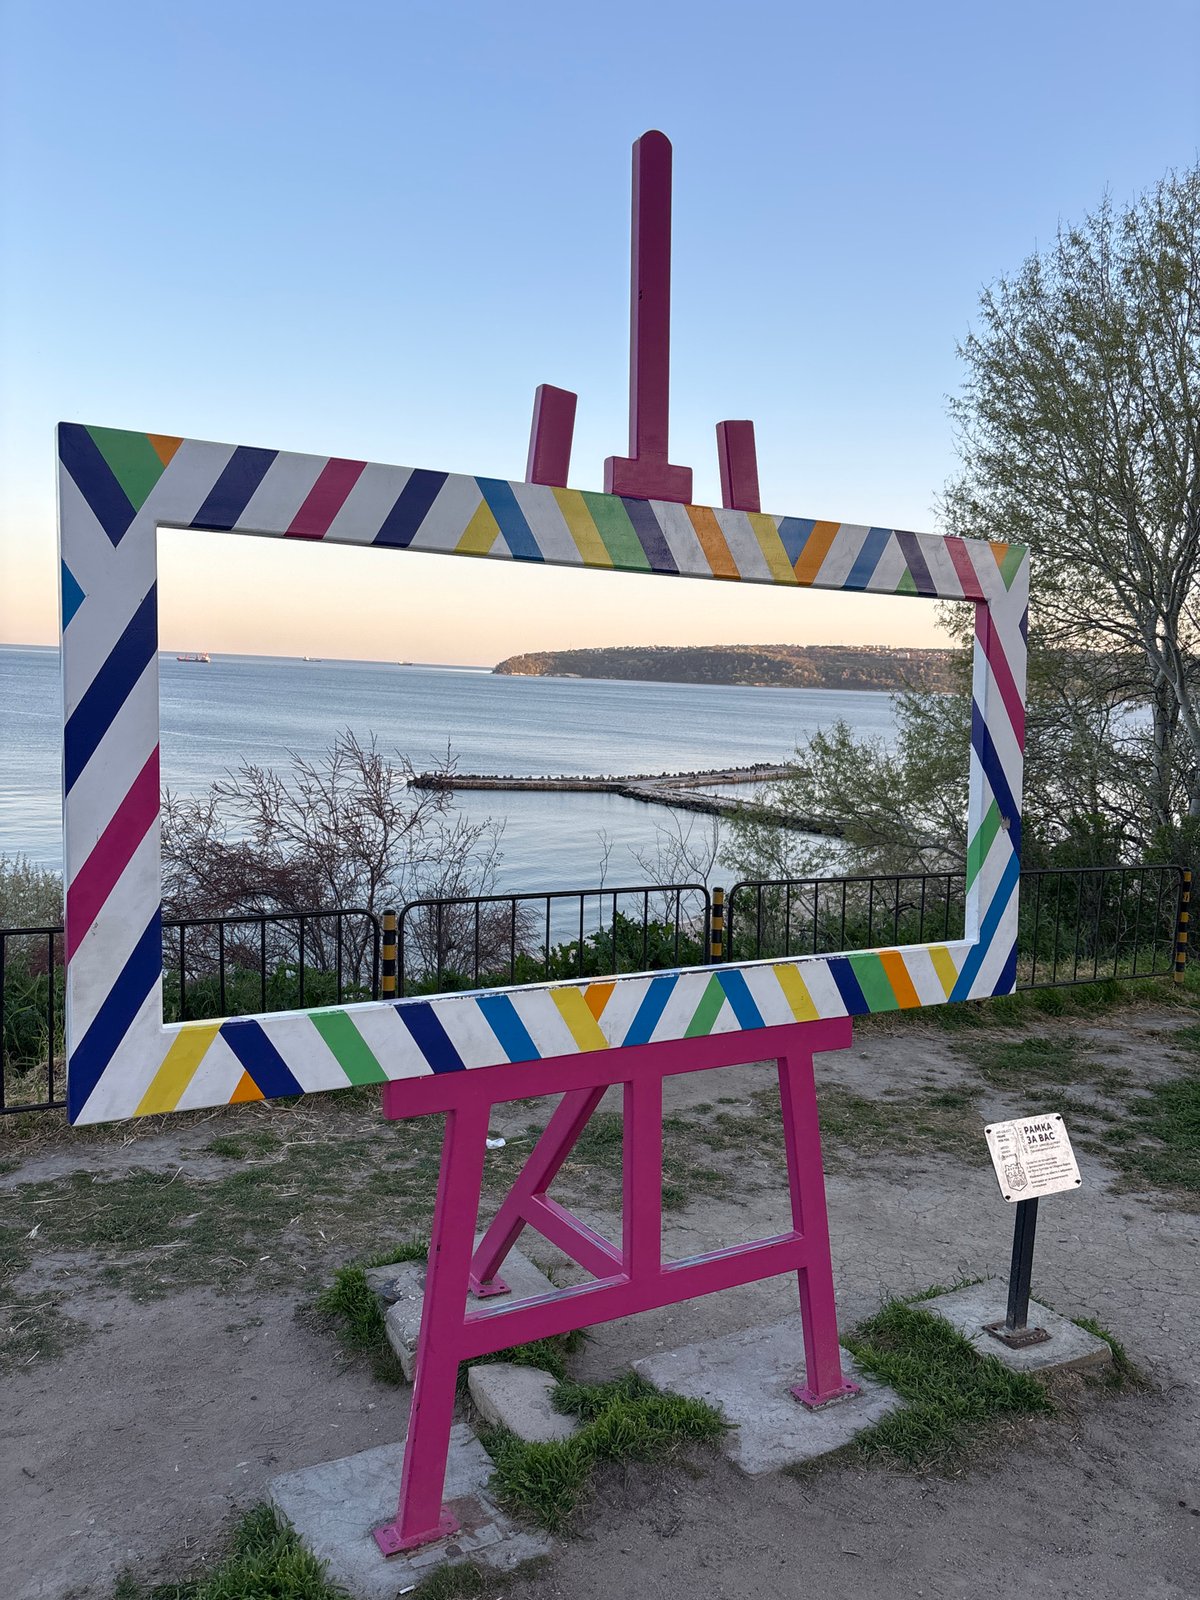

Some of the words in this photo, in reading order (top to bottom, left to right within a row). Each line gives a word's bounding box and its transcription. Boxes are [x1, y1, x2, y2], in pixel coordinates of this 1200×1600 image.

[1024, 1123, 1053, 1134] РАМКА
[1026, 1135, 1037, 1144] ЗА
[1039, 1132, 1055, 1142] ВАС
